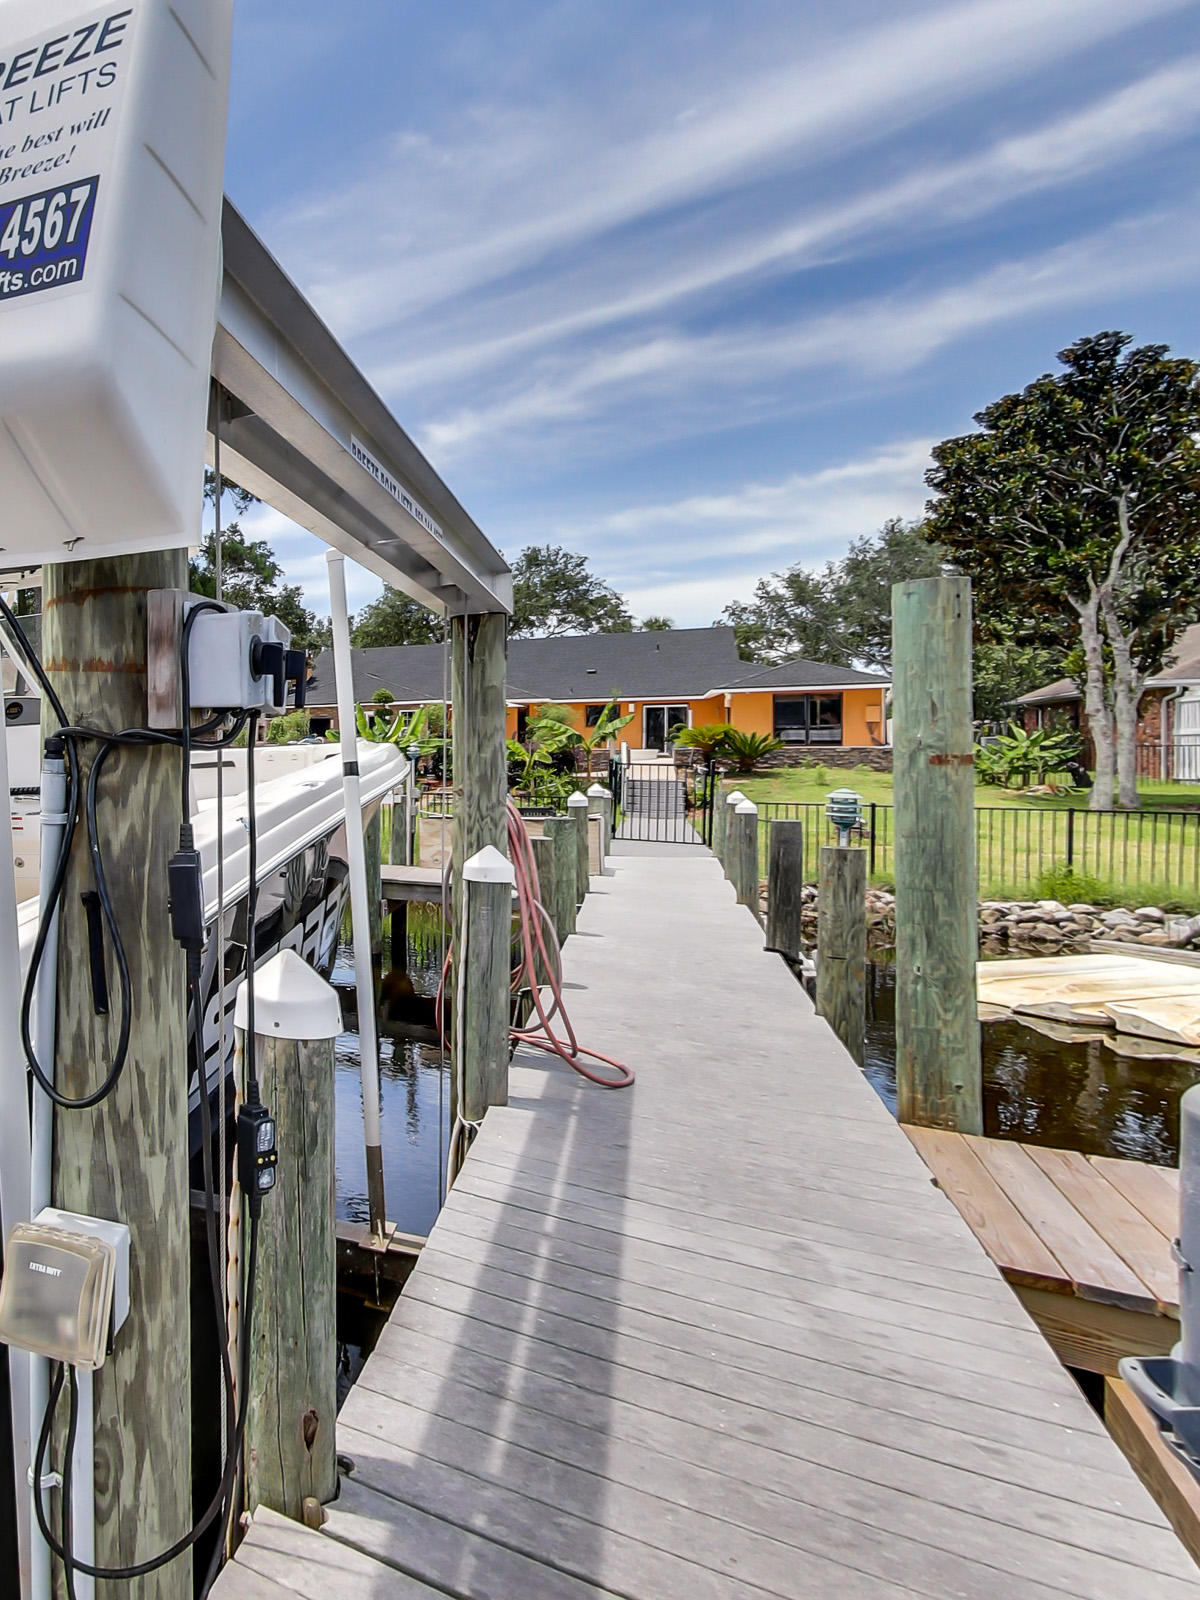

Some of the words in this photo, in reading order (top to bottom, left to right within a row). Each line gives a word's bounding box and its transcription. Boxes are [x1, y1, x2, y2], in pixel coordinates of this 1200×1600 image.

[29, 61, 118, 114] LIFTS
[20, 127, 63, 154] best
[69, 106, 112, 138] will
